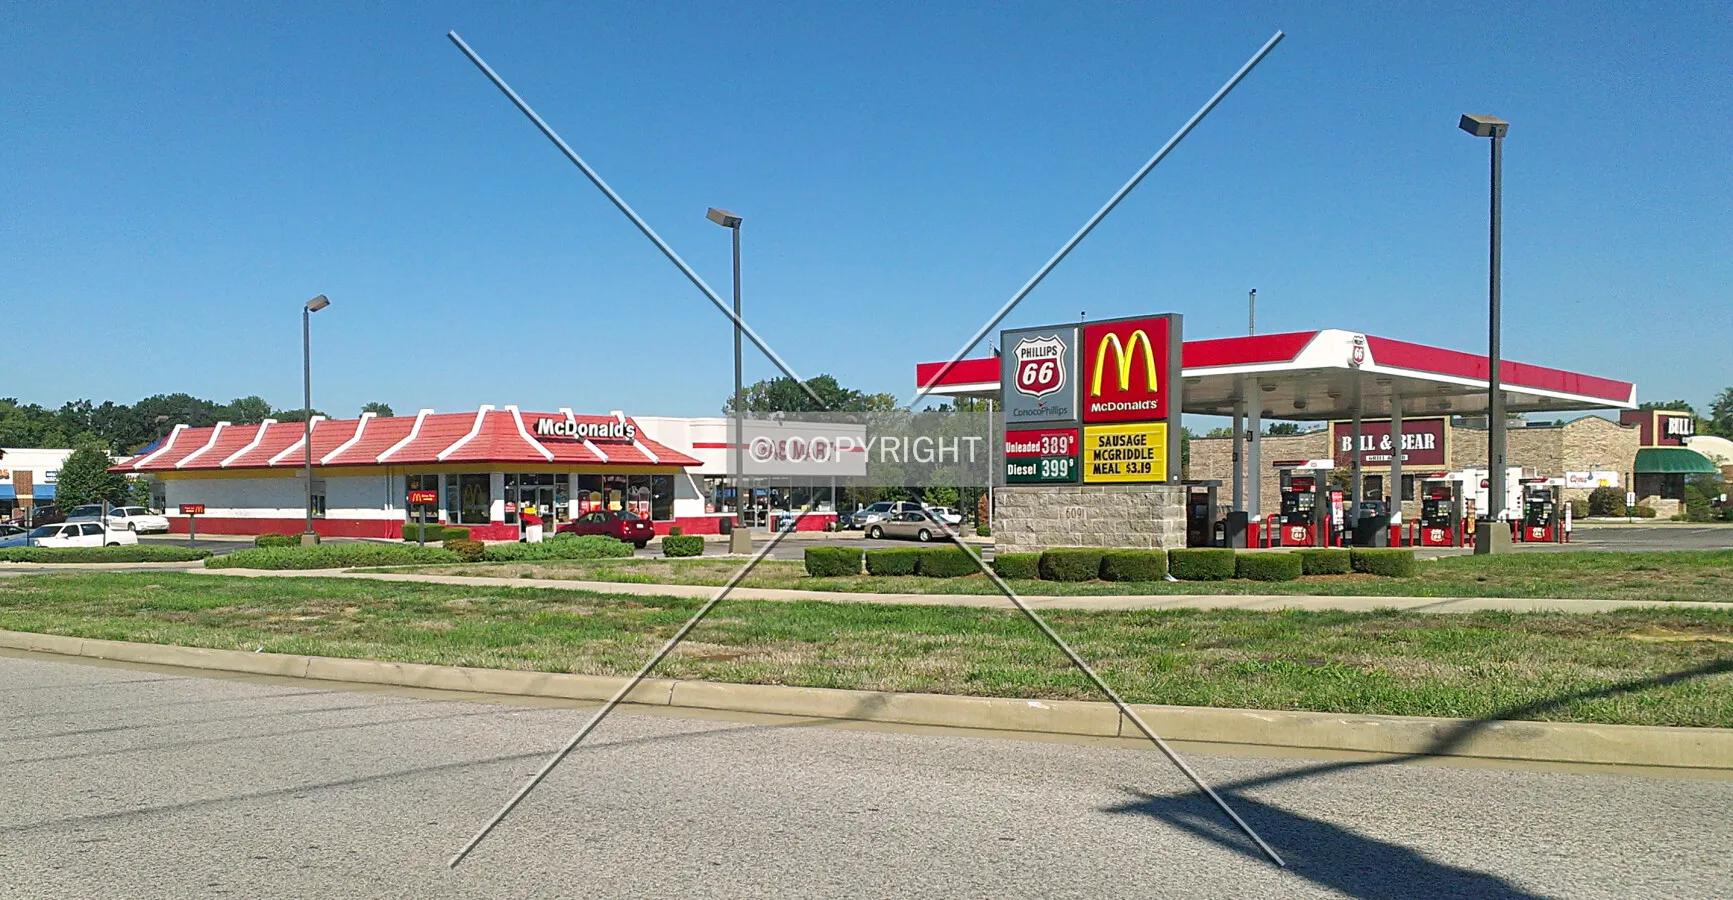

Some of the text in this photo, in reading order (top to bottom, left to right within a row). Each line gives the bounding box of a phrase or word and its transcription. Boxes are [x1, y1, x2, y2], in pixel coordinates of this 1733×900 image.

[1020, 345, 1058, 358] PHILLIPS
[1355, 347, 1363, 360] 66
[1022, 361, 1055, 386] 66
[1013, 405, 1068, 417] ConocoPhillips
[1091, 399, 1157, 413] McDonald's
[537, 417, 636, 439] McDonald's
[1668, 417, 1689, 435] BULL
[1005, 440, 1041, 454] Unleaded
[1041, 436, 1068, 454] 389
[1098, 433, 1148, 447] SAUSAGE
[1341, 433, 1435, 452] BLL & BEAR
[1093, 447, 1154, 461] MCGRIDDLE
[1007, 463, 1037, 475] Diesel
[1041, 459, 1069, 477] 399
[1093, 461, 1152, 475] MEAL $3.19
[1065, 508, 1085, 519] 6091
